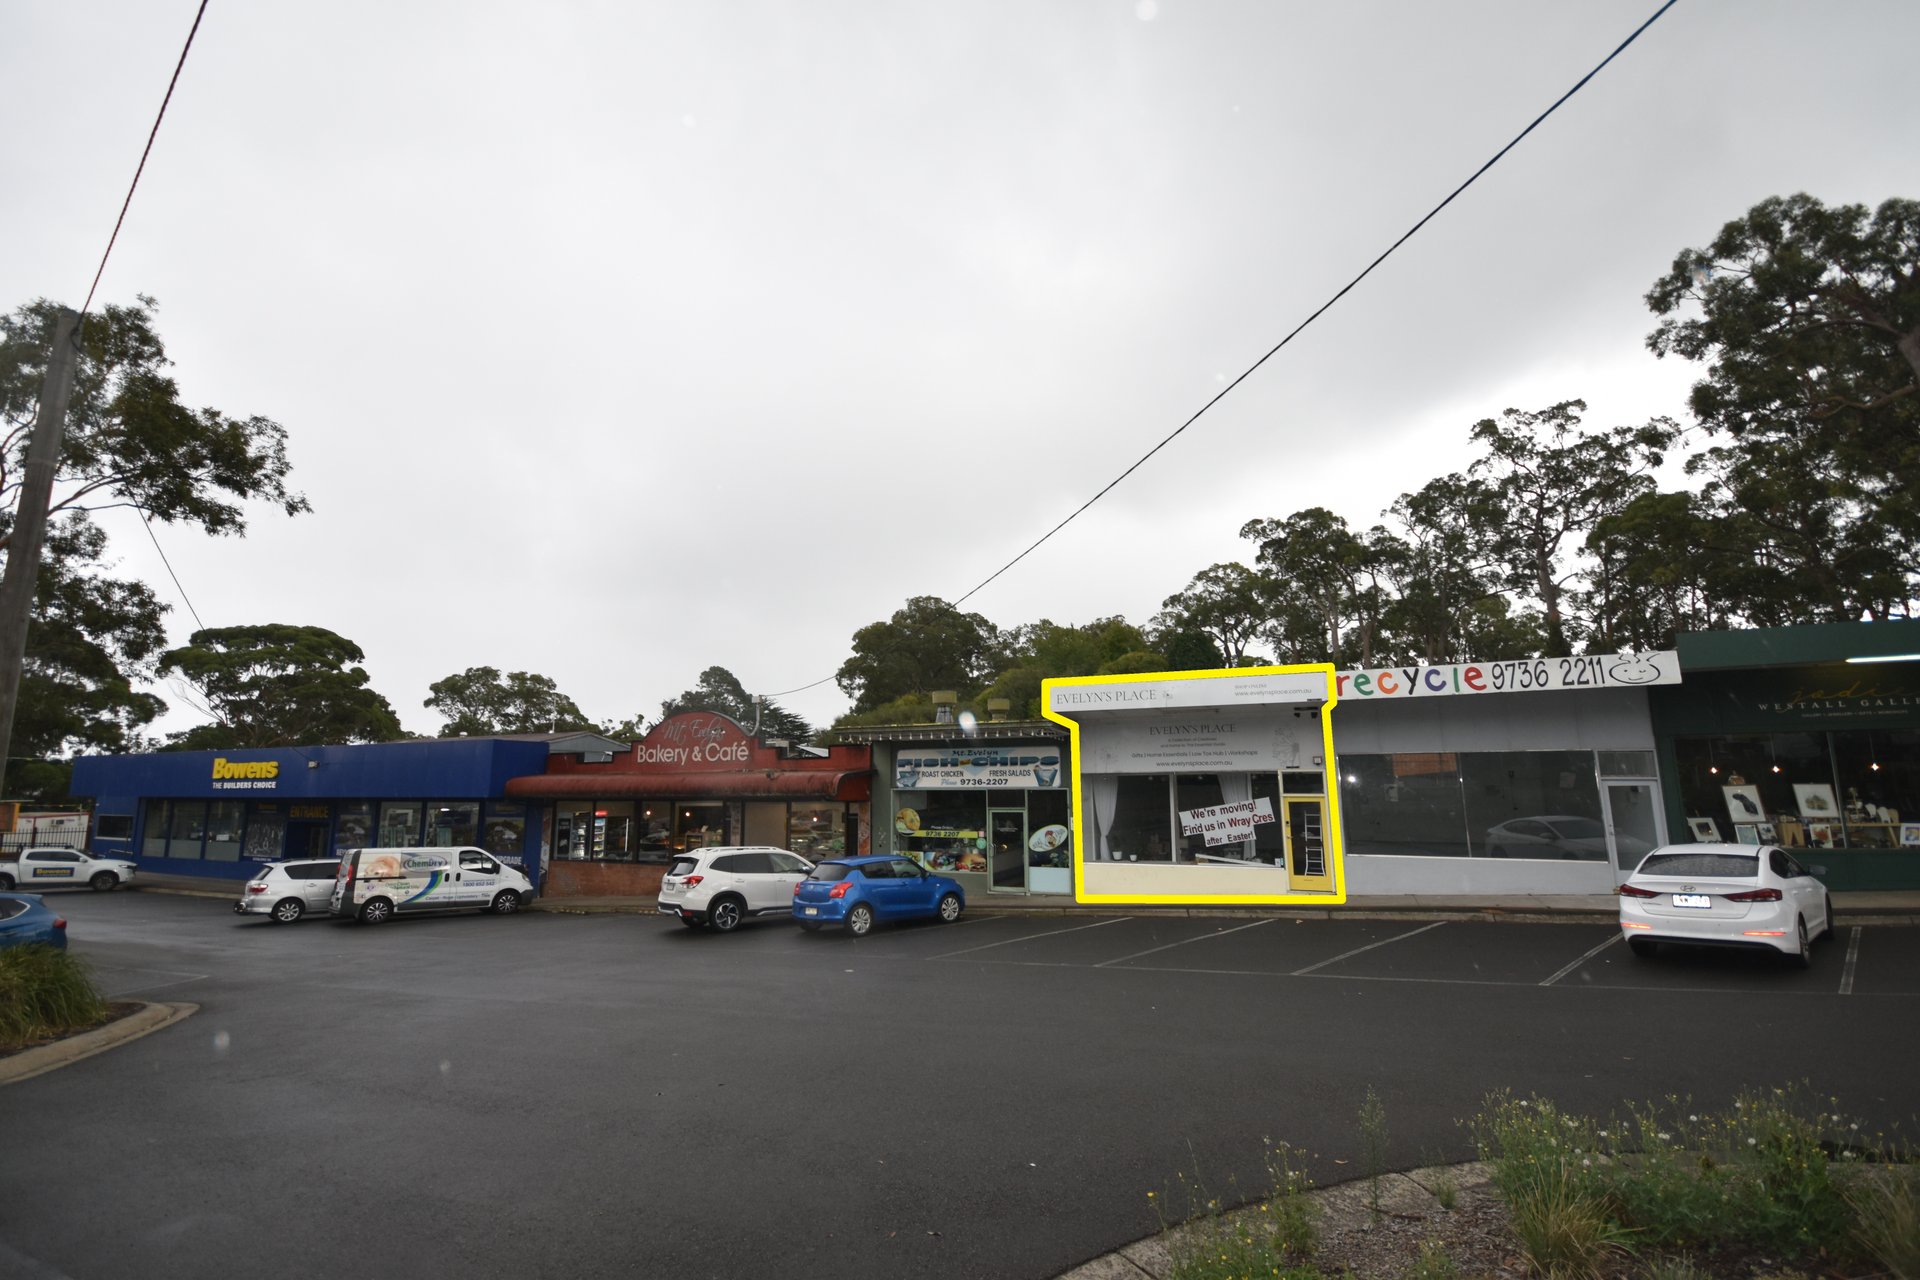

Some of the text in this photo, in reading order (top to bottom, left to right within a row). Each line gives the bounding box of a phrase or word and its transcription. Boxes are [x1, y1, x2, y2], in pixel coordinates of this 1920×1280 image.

[1336, 656, 1605, 697] recycle 9736 2211
[1056, 689, 1157, 704] EVELYN'S PLACE
[1758, 700, 1846, 711] WESTALL
[1149, 723, 1237, 736] EVELYN'S PLACE
[637, 740, 749, 766] Bakery & Café
[212, 757, 279, 779] Bowens
[971, 756, 1059, 767] CHIPS
[1007, 769, 1031, 777] SALADS
[223, 781, 252, 789] BUILDERS
[252, 781, 277, 789] CHOICE
[289, 805, 329, 818] ENTRANCE
[1190, 800, 1257, 819] We're moving!
[1183, 813, 1274, 835] Find us in Wray Cres
[1206, 831, 1254, 846] after Easter!
